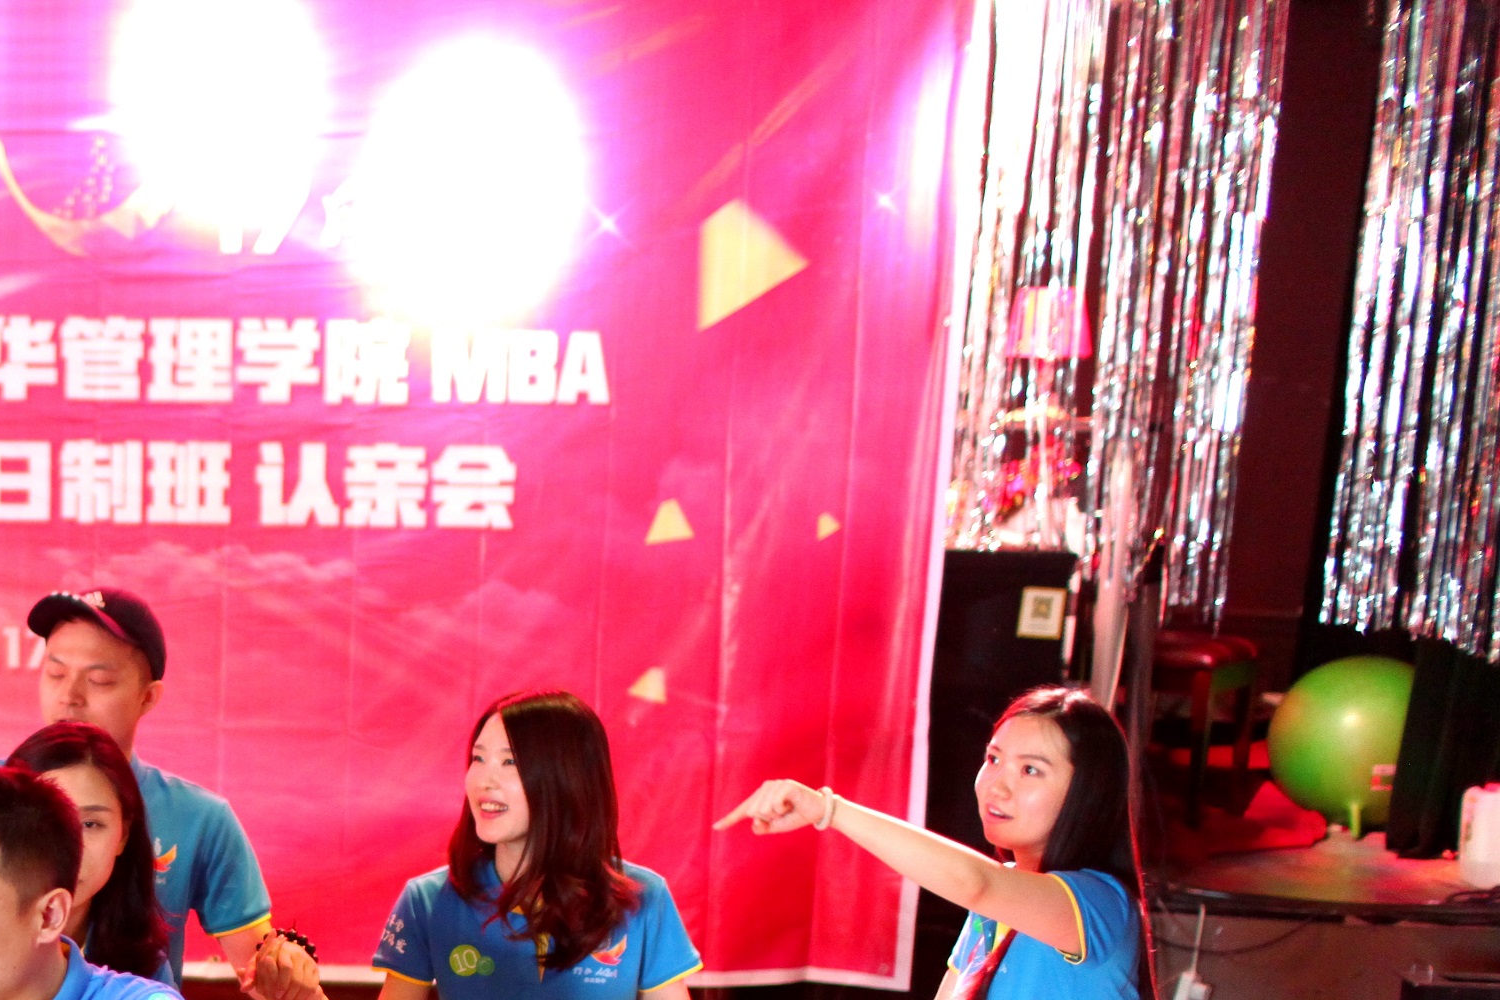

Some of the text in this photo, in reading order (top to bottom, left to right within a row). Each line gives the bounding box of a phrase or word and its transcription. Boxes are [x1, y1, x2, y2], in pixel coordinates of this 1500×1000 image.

[430, 329, 610, 405] MBA
[255, 442, 517, 530] 认亲会
[452, 948, 478, 973] 10
